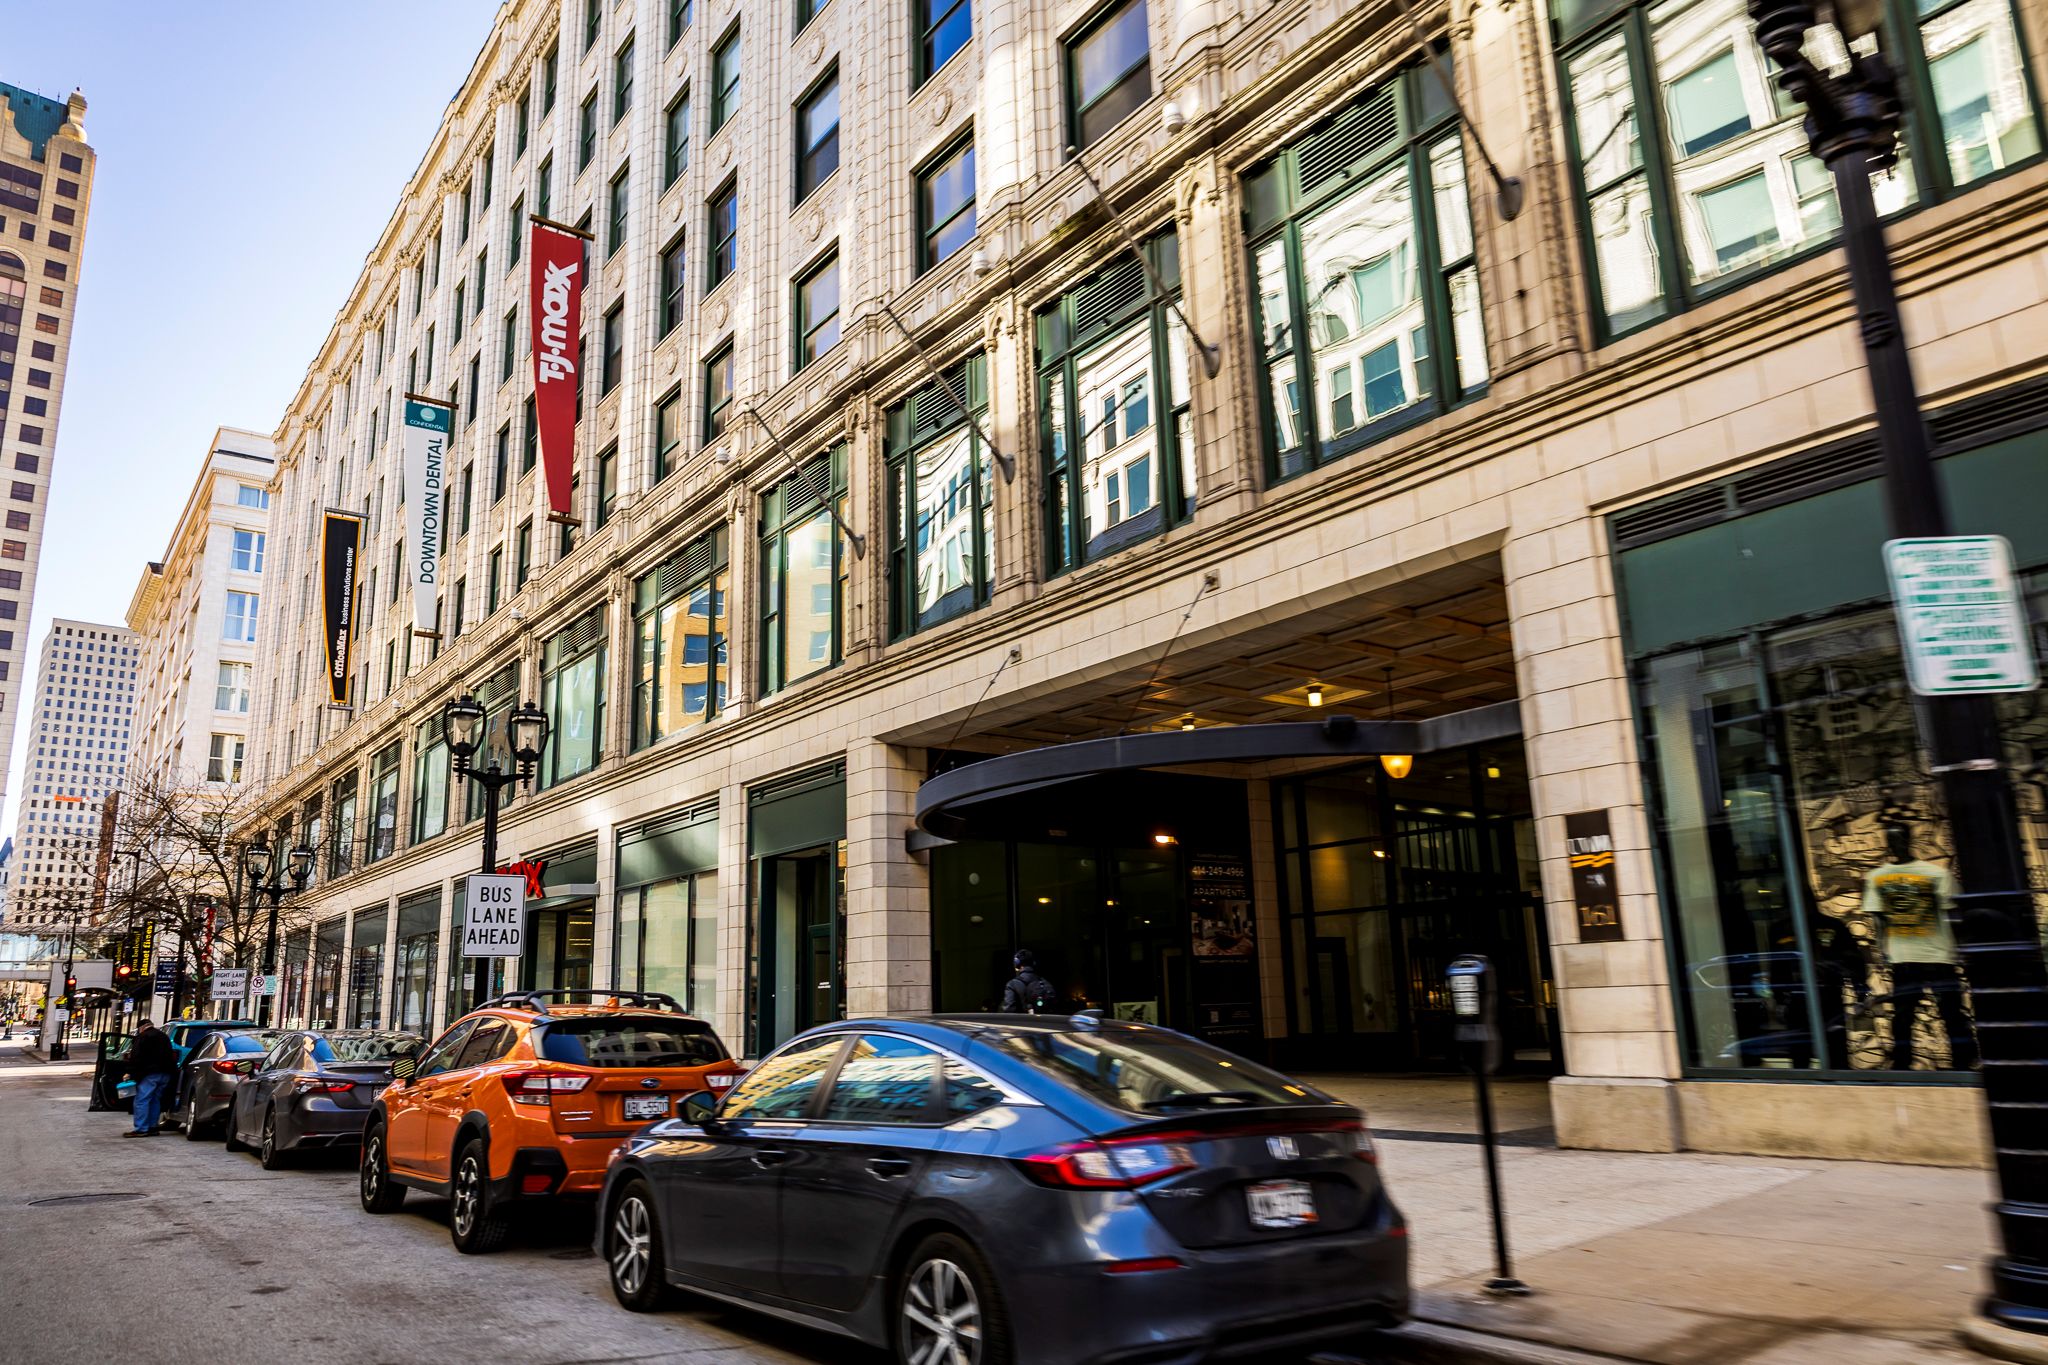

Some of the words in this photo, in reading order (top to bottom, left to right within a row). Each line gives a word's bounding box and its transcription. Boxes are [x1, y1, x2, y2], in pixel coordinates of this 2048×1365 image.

[426, 438, 443, 489] DENTAL
[420, 492, 440, 584] DOWNTOWN
[334, 629, 347, 679] OfficeMax
[341, 596, 350, 625] business
[480, 886, 512, 903] BUS
[1192, 887, 1247, 898] APARTMENTS
[472, 907, 517, 924] LANE
[467, 928, 520, 945] AHEAD
